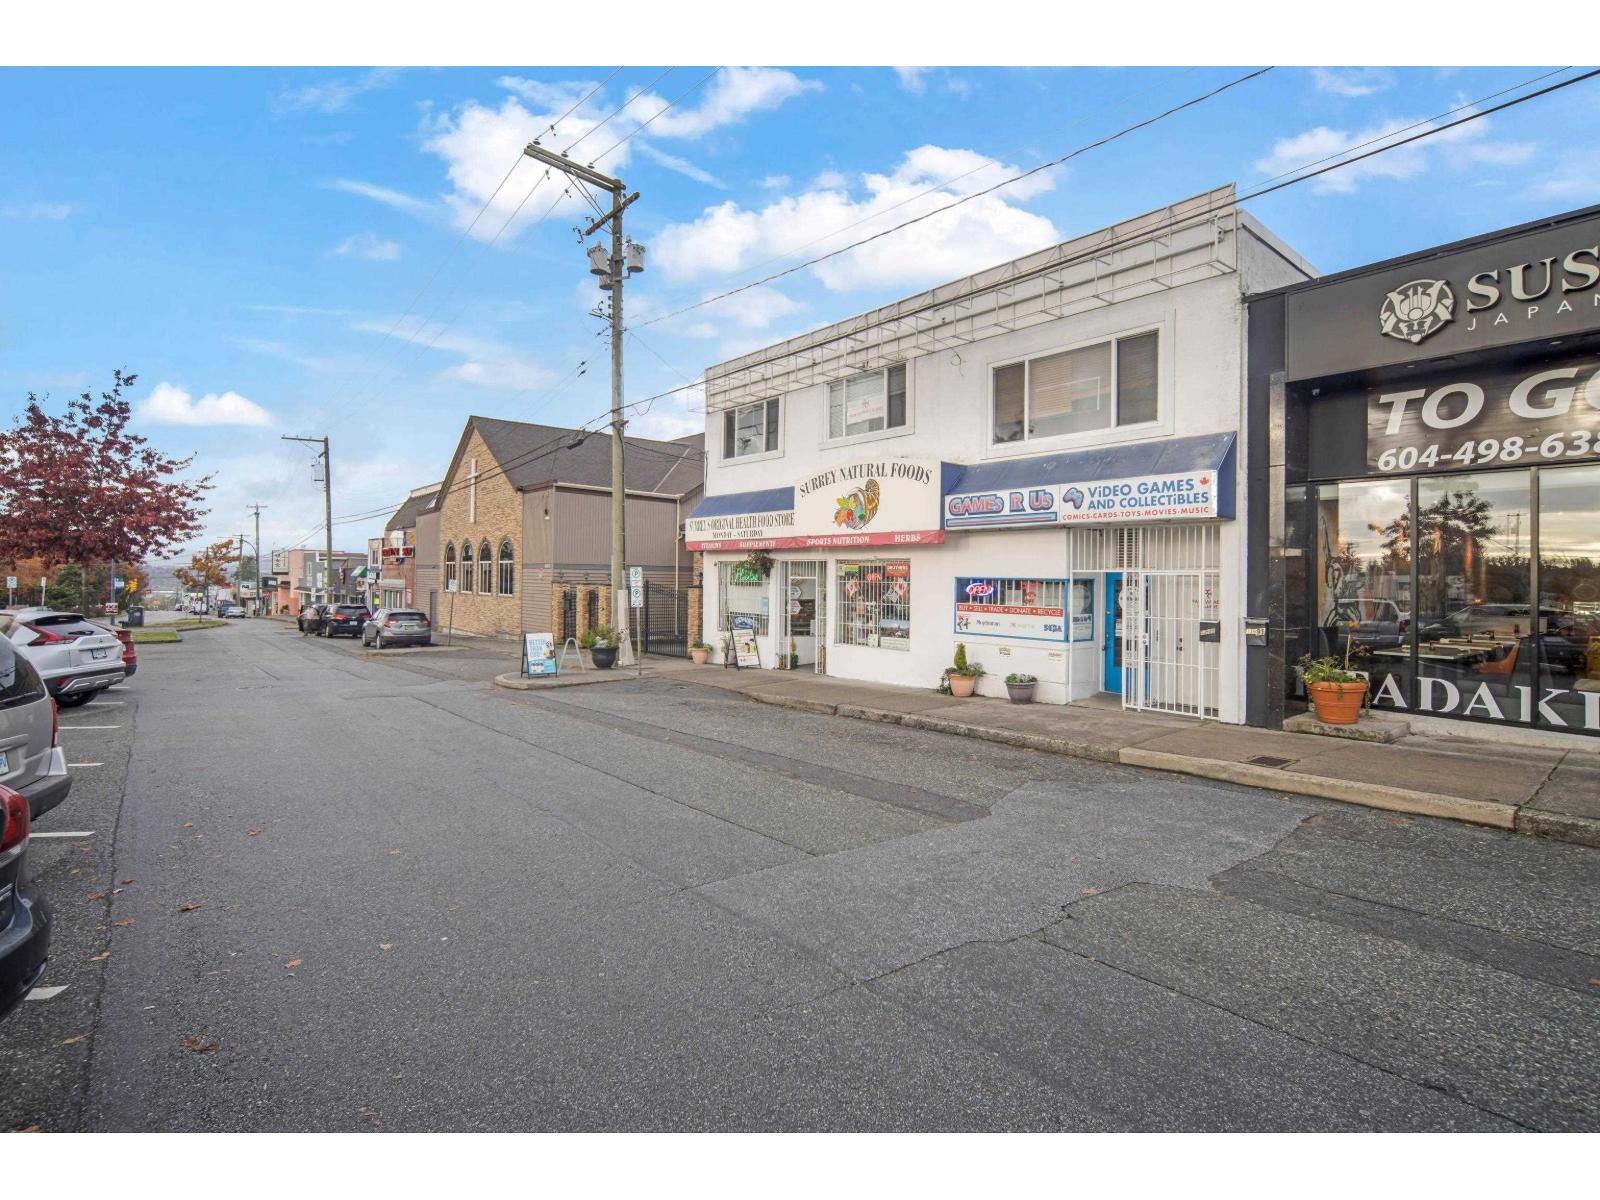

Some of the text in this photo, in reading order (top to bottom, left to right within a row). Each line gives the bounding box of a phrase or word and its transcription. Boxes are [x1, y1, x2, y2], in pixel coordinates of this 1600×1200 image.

[1379, 367, 1600, 435] TO G
[799, 462, 932, 498] SURREY NATURAL FOODS
[1137, 479, 1194, 495] GAMES
[1009, 491, 1026, 512] R
[1087, 498, 1116, 511] AND
[735, 515, 757, 529] HEALTH
[757, 513, 773, 527] FOOD
[774, 512, 795, 526] STORE
[832, 535, 870, 544] NUTRITION
[894, 534, 921, 543] HERBS
[1037, 608, 1061, 616] RECYCLE
